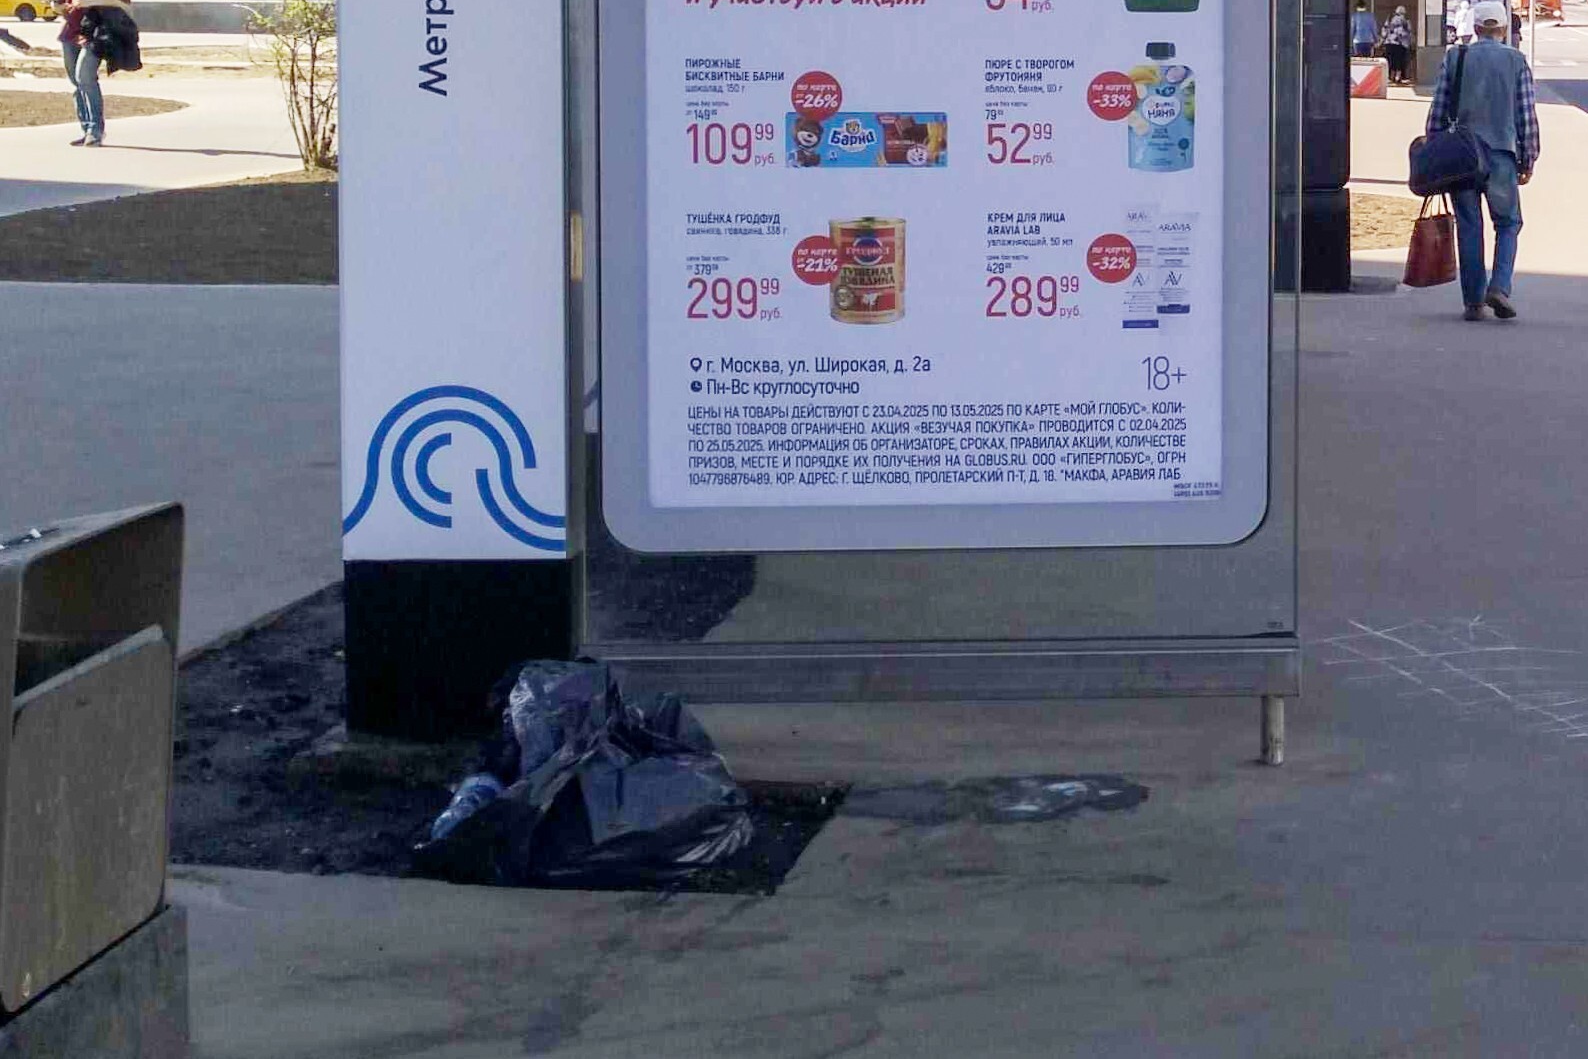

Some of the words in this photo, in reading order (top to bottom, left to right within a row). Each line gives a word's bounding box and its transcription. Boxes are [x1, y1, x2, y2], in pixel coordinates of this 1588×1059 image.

[685, 58, 741, 69] ПИРОЖНЫЕ
[985, 59, 1012, 69] ПЮРЕ
[1024, 59, 1074, 69] ТВОРОГОМ
[685, 71, 750, 81] БИСКВИТНЫЕ
[752, 71, 784, 81] БАРНИ
[985, 71, 1042, 81] ФРУТОНЯНЯ
[686, 123, 752, 165] 109
[830, 130, 875, 146] Барни
[987, 123, 1031, 163] 52
[735, 213, 780, 225] ГРОДФУД
[987, 213, 1014, 223] КРЕМ
[1016, 213, 1037, 224] ДЛЯ
[1040, 213, 1066, 224] ЛИЦА
[987, 226, 1020, 235] ARAVIA
[1024, 226, 1041, 235] LAB
[687, 278, 757, 319] 299
[986, 276, 1057, 317] 289
[707, 360, 715, 373] г.
[721, 357, 783, 375] Москва,
[788, 359, 808, 375] ул.
[815, 357, 889, 375] Широкая,
[894, 360, 908, 374] д.
[913, 356, 931, 372] 2а
[1141, 356, 1187, 390] 18+
[706, 379, 749, 394] Пн-Вс
[754, 381, 860, 398] круглосуточно
[688, 406, 721, 419] ЦЕНЫ
[724, 406, 739, 418] НА
[742, 406, 788, 418] ТОВАРЫ
[791, 403, 859, 419] ДЕЙСТВУЮТ
[862, 406, 870, 417] С
[872, 405, 929, 417] 23.04.2025
[932, 405, 948, 417] ПО
[950, 404, 1004, 417] 13.05.2025
[1007, 404, 1022, 416] ПО
[1025, 404, 1060, 416] КАРТЕ
[1064, 401, 1095, 415] «МОЙ
[1152, 402, 1186, 414] КОЛИ-
[687, 423, 731, 435] ЧЕСТВО
[736, 423, 787, 435] ТОВАРОВ
[871, 422, 910, 435] АКЦИЯ
[914, 422, 971, 434] «ВЕЗУЧАЯ
[976, 421, 1035, 433] ПОКУПКА»
[1039, 420, 1114, 433] ПРОВОДИТСЯ
[1118, 419, 1126, 431] С
[1130, 418, 1187, 431] 02.04.2025
[688, 440, 704, 452] ПО
[768, 439, 849, 452] ИНФОРМАЦИЯ
[852, 439, 868, 451] ОБ
[871, 438, 958, 451] ОРГАНИЗАТОРЕ,
[960, 438, 1008, 450] СРОКАХ,
[1010, 437, 1069, 449] ПРАВИЛАХ
[1072, 436, 1113, 449] АКЦИИ,
[1116, 435, 1186, 447] КОЛИЧЕСТВЕ
[688, 456, 737, 469] ПРИЗОВ,
[741, 456, 779, 468] МЕСТЕ
[783, 456, 791, 468] И
[796, 455, 848, 468] ПОРЯДКЕ
[854, 455, 869, 467] ИХ
[873, 455, 940, 467] ПОЛУЧЕНИЯ
[945, 454, 960, 466] НА
[1032, 453, 1056, 465] ООО
[1060, 452, 1153, 465] «ГИПЕРГЛОБУС»,
[1158, 451, 1186, 463] ОГРН
[852, 469, 912, 485] ЩЁЛКОВО,
[915, 468, 1003, 483] ПРОЛЕТАРСКИЙ
[1007, 470, 1026, 483] П-Т,
[1111, 468, 1155, 481] АРАВИЯ
[1159, 468, 1181, 480] ЛАБ
